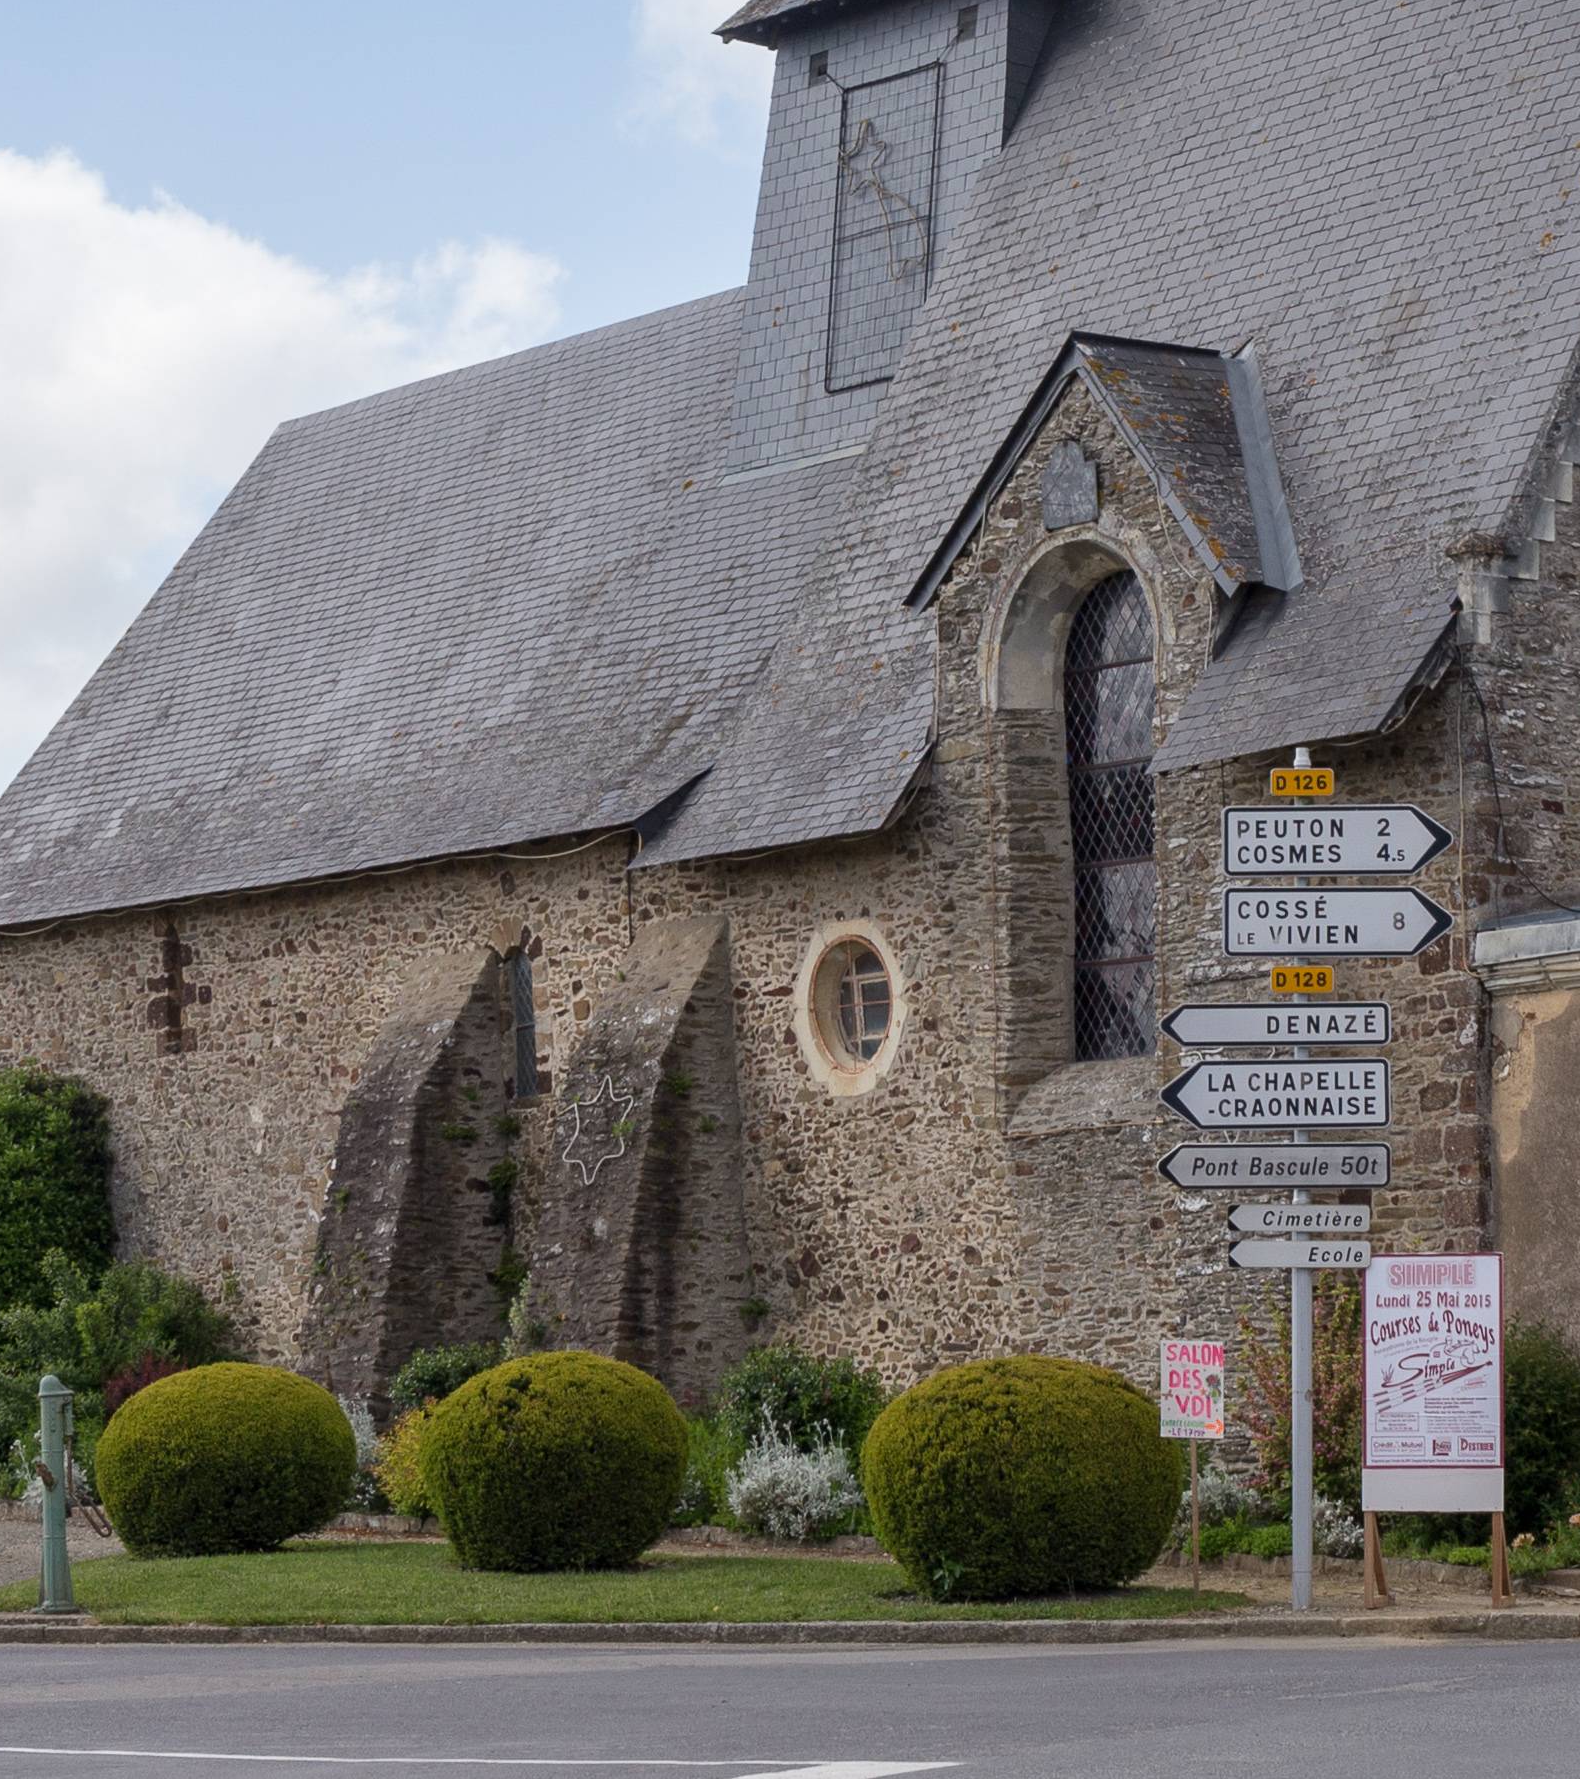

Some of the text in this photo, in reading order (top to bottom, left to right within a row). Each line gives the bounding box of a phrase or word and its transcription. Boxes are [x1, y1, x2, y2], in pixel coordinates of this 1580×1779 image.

[1276, 775, 1328, 791] D 126
[1237, 818, 1391, 839] PEUTON 2
[1237, 843, 1406, 864] COSMES 4.5
[1237, 896, 1405, 931] COSSÉ 8
[1237, 925, 1359, 945] LE VIVIEN
[1276, 972, 1328, 988] D 128
[1266, 1010, 1377, 1034] DENAZÉ
[1208, 1071, 1377, 1093] LA CHAPELLE
[1208, 1096, 1377, 1118] -CRAONNAISE
[1192, 1156, 1379, 1177] Pont Bascule 50t
[1263, 1210, 1364, 1227] Cimetière
[1308, 1246, 1364, 1262] Ecole
[1389, 1259, 1475, 1288] SIMPLÉ
[1376, 1290, 1492, 1308] Lundi 25 Mai 2015
[1370, 1315, 1421, 1346] Courses
[1428, 1311, 1439, 1332] de
[1442, 1309, 1495, 1354] Poneys
[1166, 1343, 1224, 1367] SALON
[1169, 1369, 1202, 1390] DES
[1175, 1395, 1212, 1419] VDI
